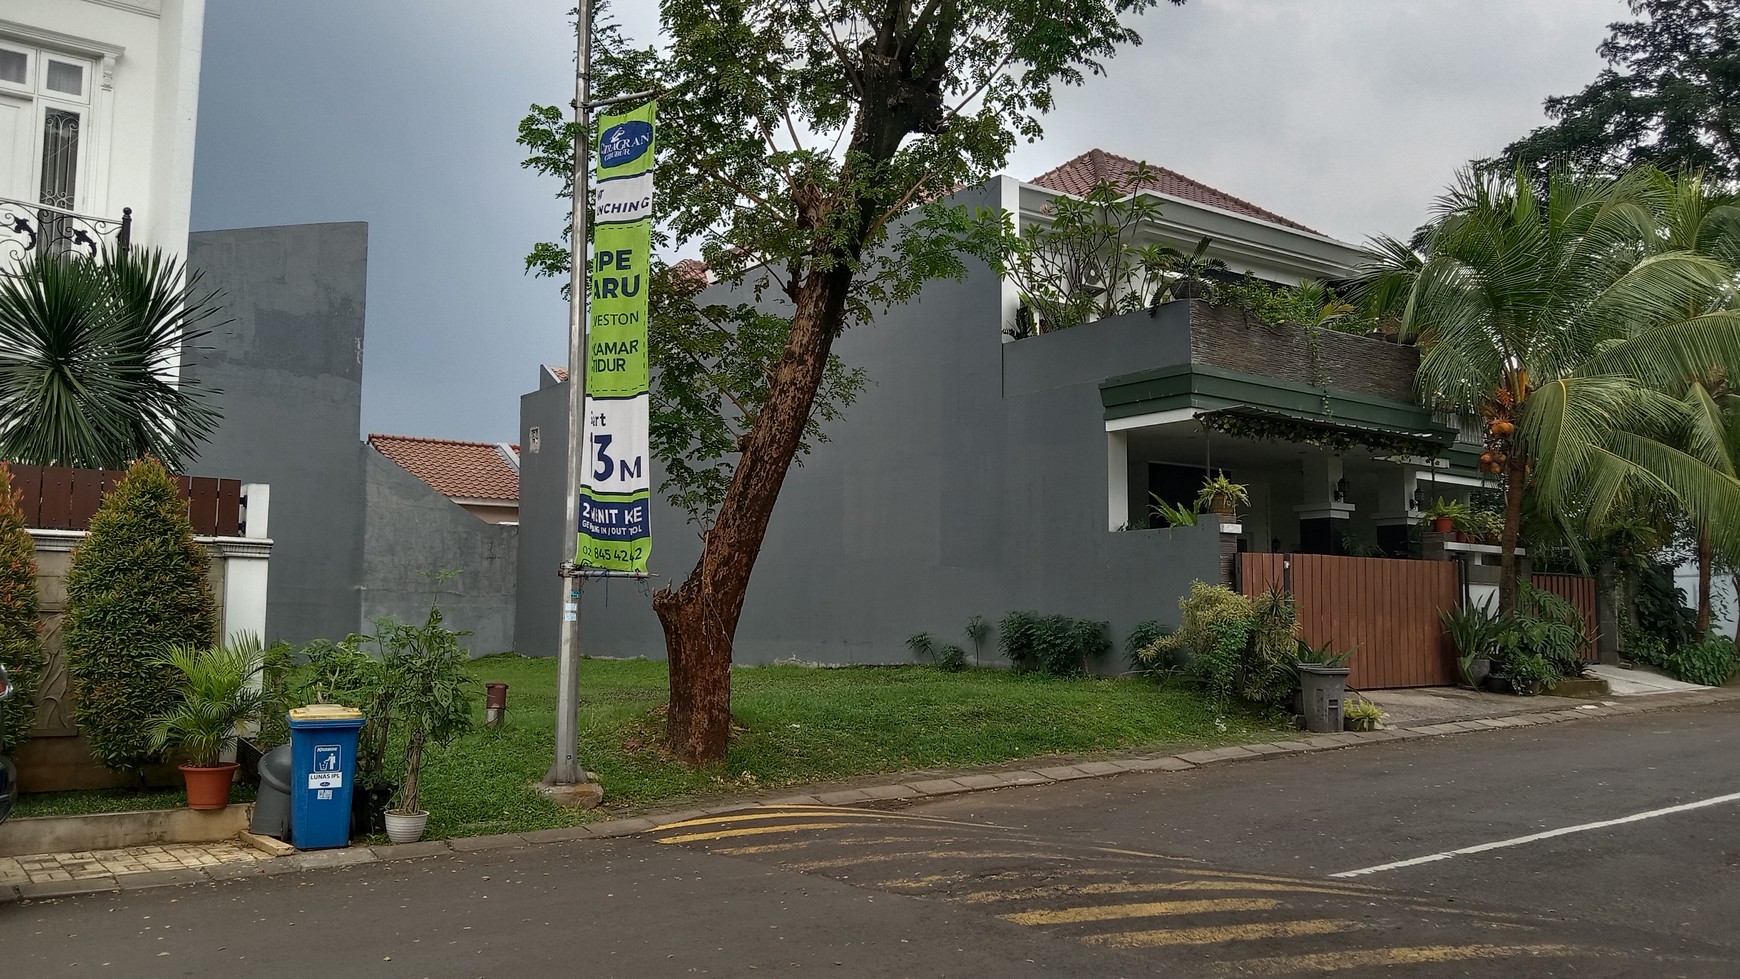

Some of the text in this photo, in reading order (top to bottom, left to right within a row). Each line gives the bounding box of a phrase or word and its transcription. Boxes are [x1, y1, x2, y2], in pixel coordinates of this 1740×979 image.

[620, 455, 642, 482] M
[582, 502, 590, 518] 2
[624, 506, 643, 524] KE
[628, 525, 643, 536] TOL
[594, 547, 611, 560] 845
